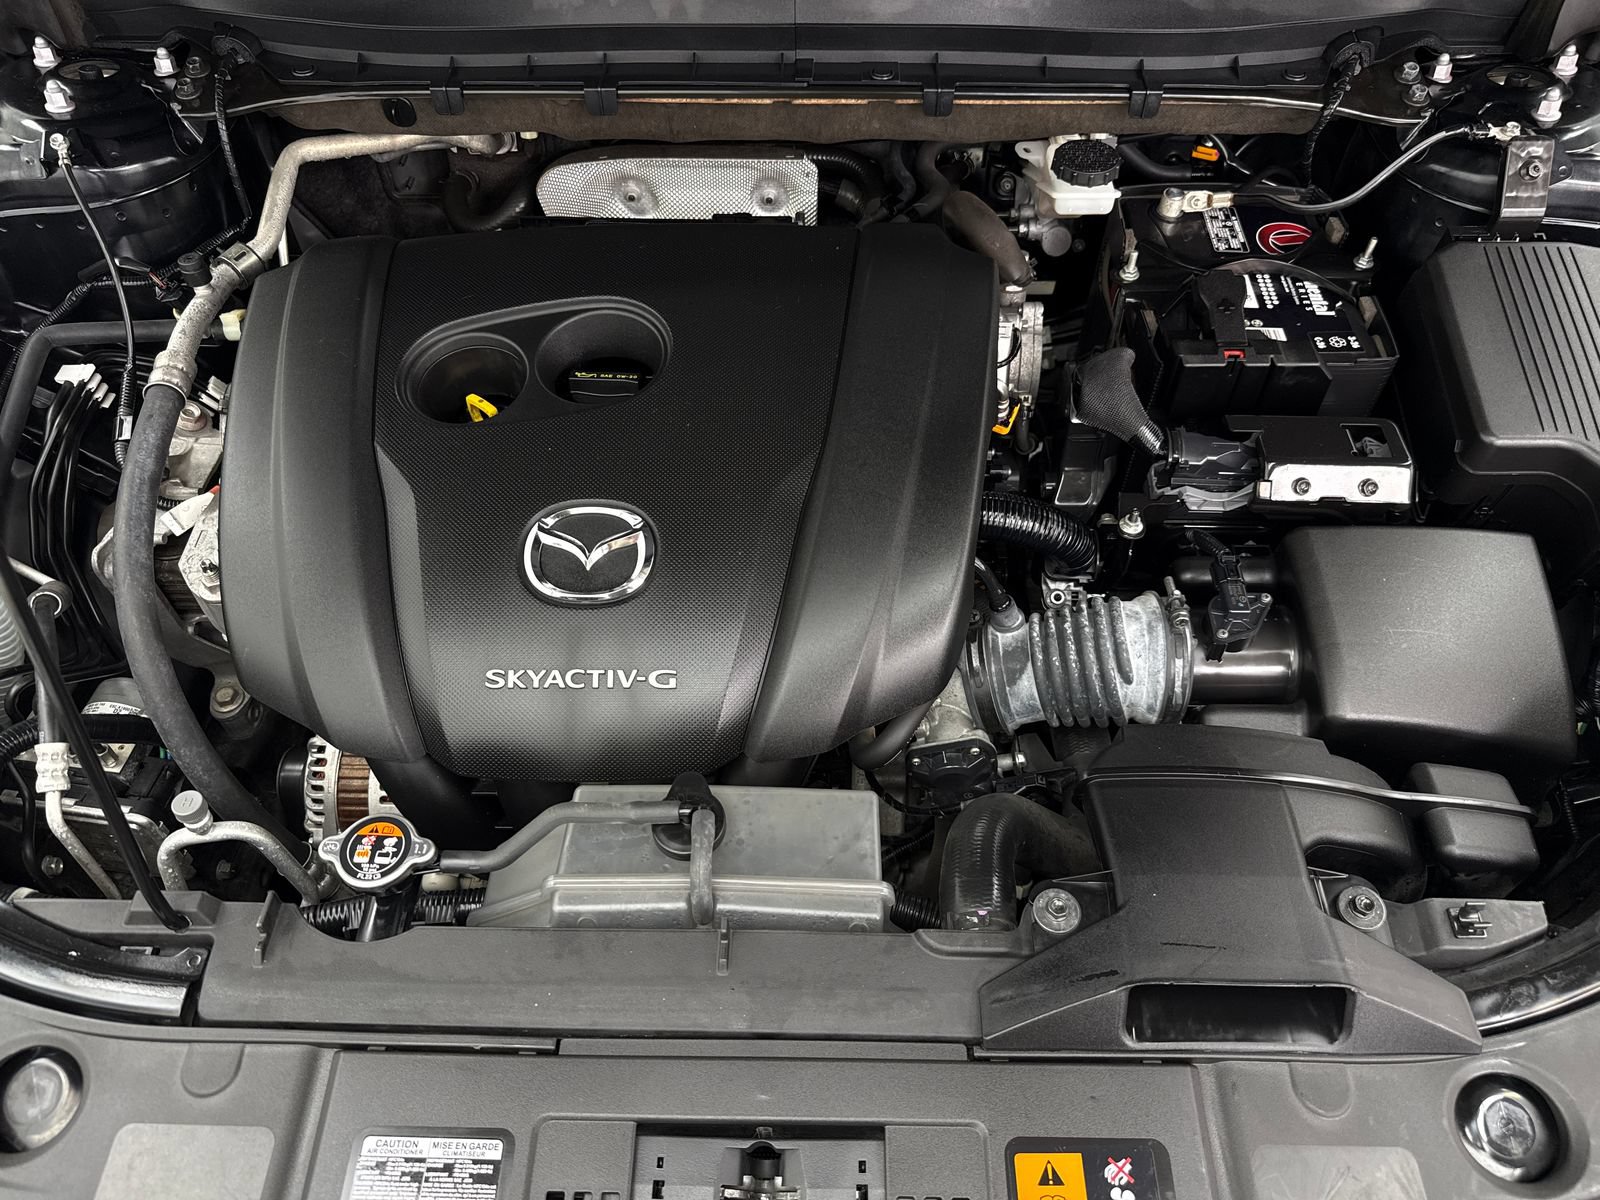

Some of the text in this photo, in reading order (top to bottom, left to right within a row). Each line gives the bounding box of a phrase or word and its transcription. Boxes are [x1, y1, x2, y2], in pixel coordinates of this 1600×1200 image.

[1296, 282, 1313, 311] ERIES
[1303, 281, 1335, 315] nental
[484, 668, 678, 689] SKYACTIV-G
[375, 1139, 420, 1148] CAUTION
[432, 1141, 500, 1151] MISE EN GARDE
